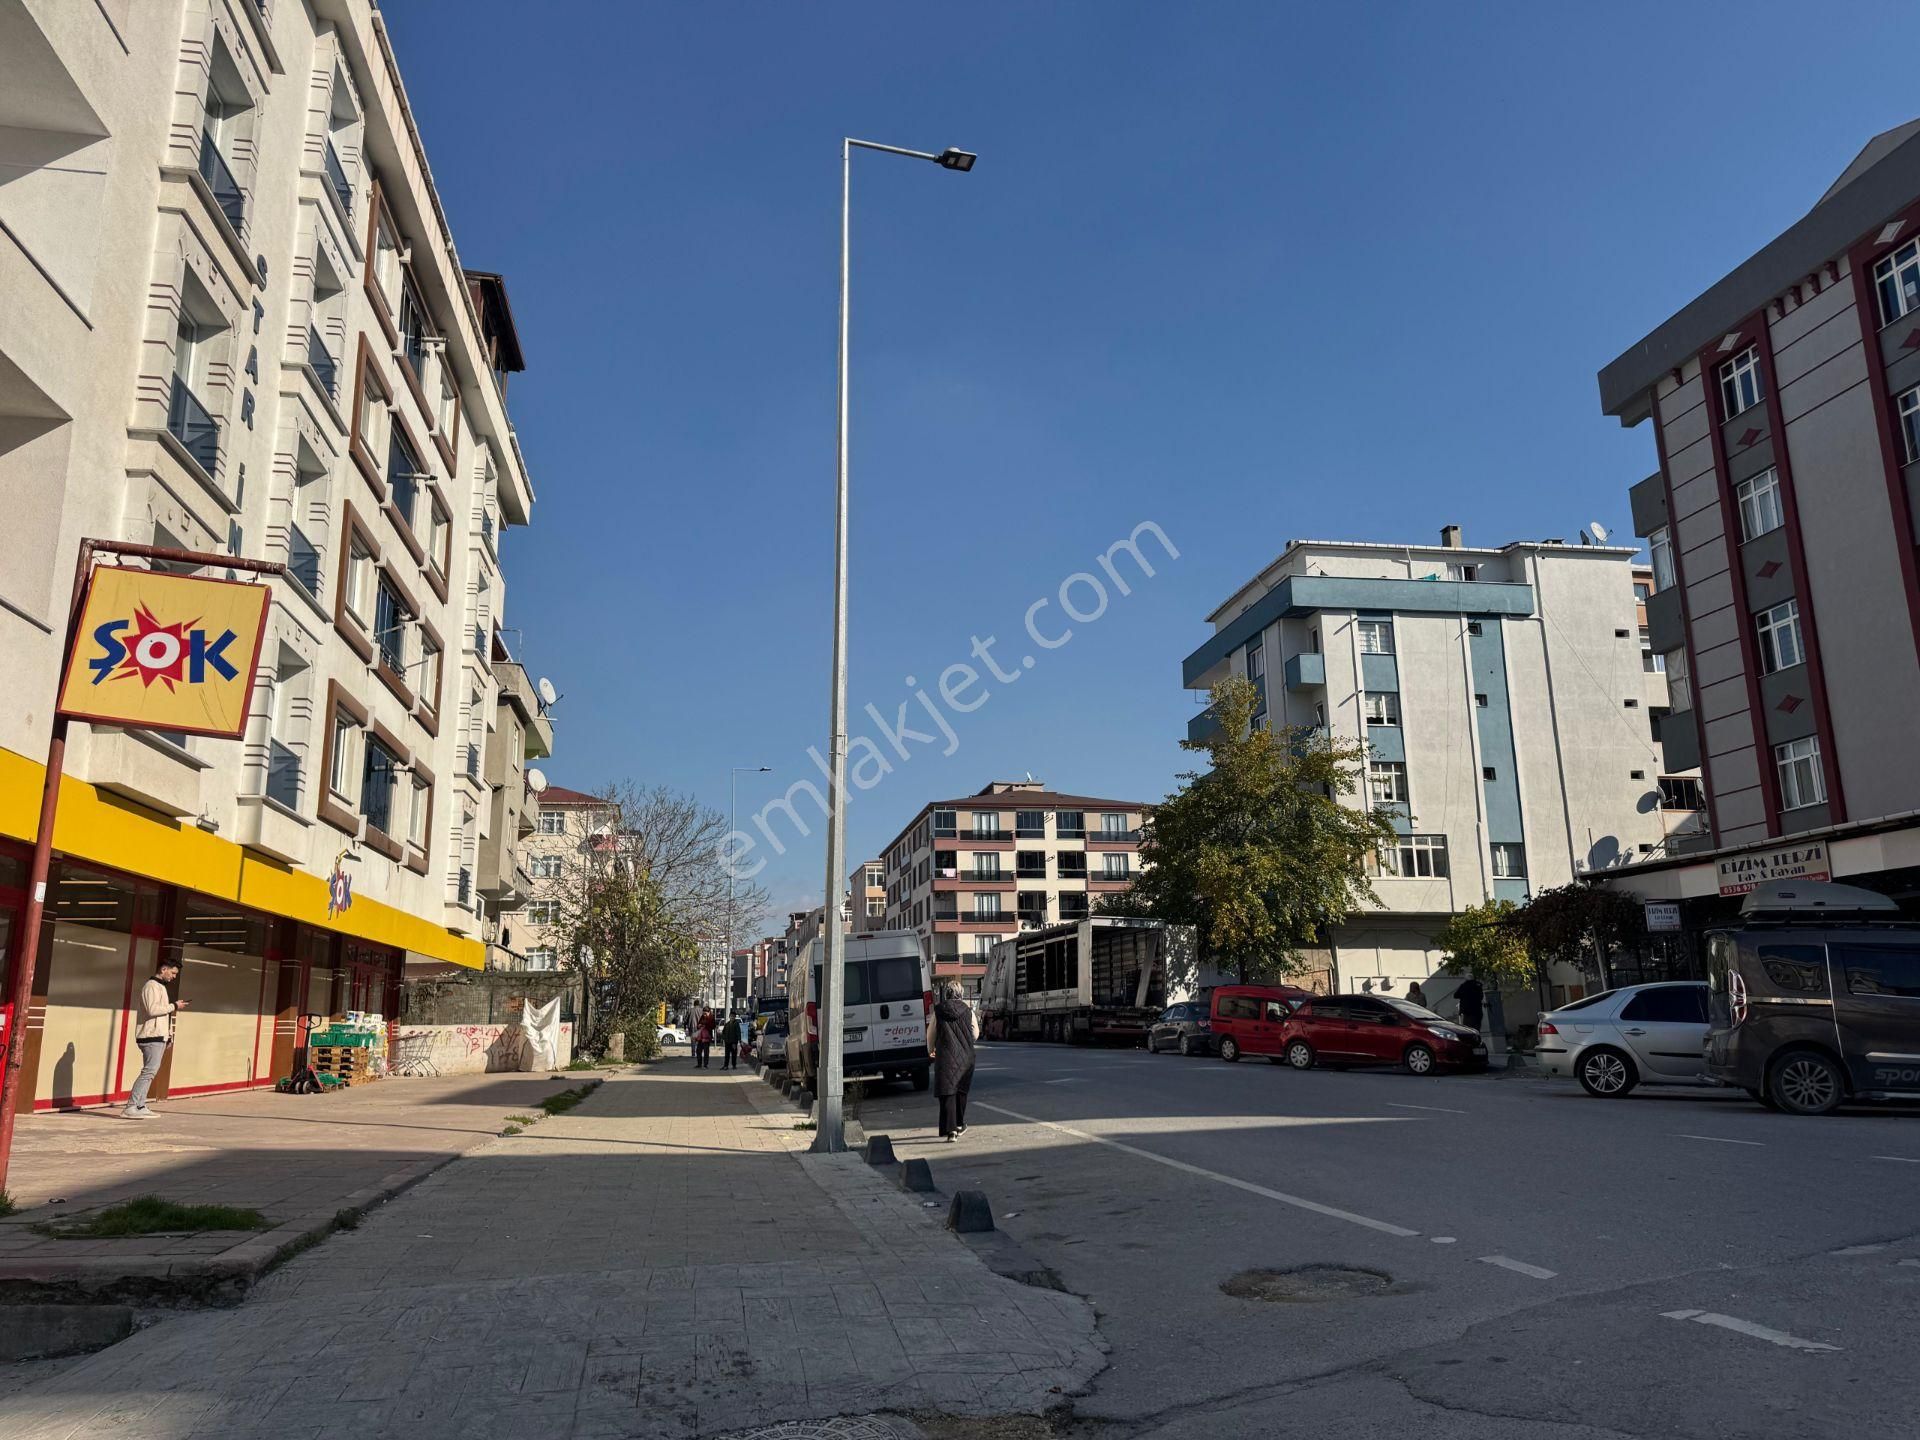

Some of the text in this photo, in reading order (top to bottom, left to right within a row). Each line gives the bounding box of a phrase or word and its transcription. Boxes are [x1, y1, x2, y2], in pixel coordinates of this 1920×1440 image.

[89, 619, 239, 686] ŞOK
[1770, 844, 1821, 866] TERZİ
[1770, 865, 1805, 878] Bayan
[892, 1026, 919, 1036] derya
